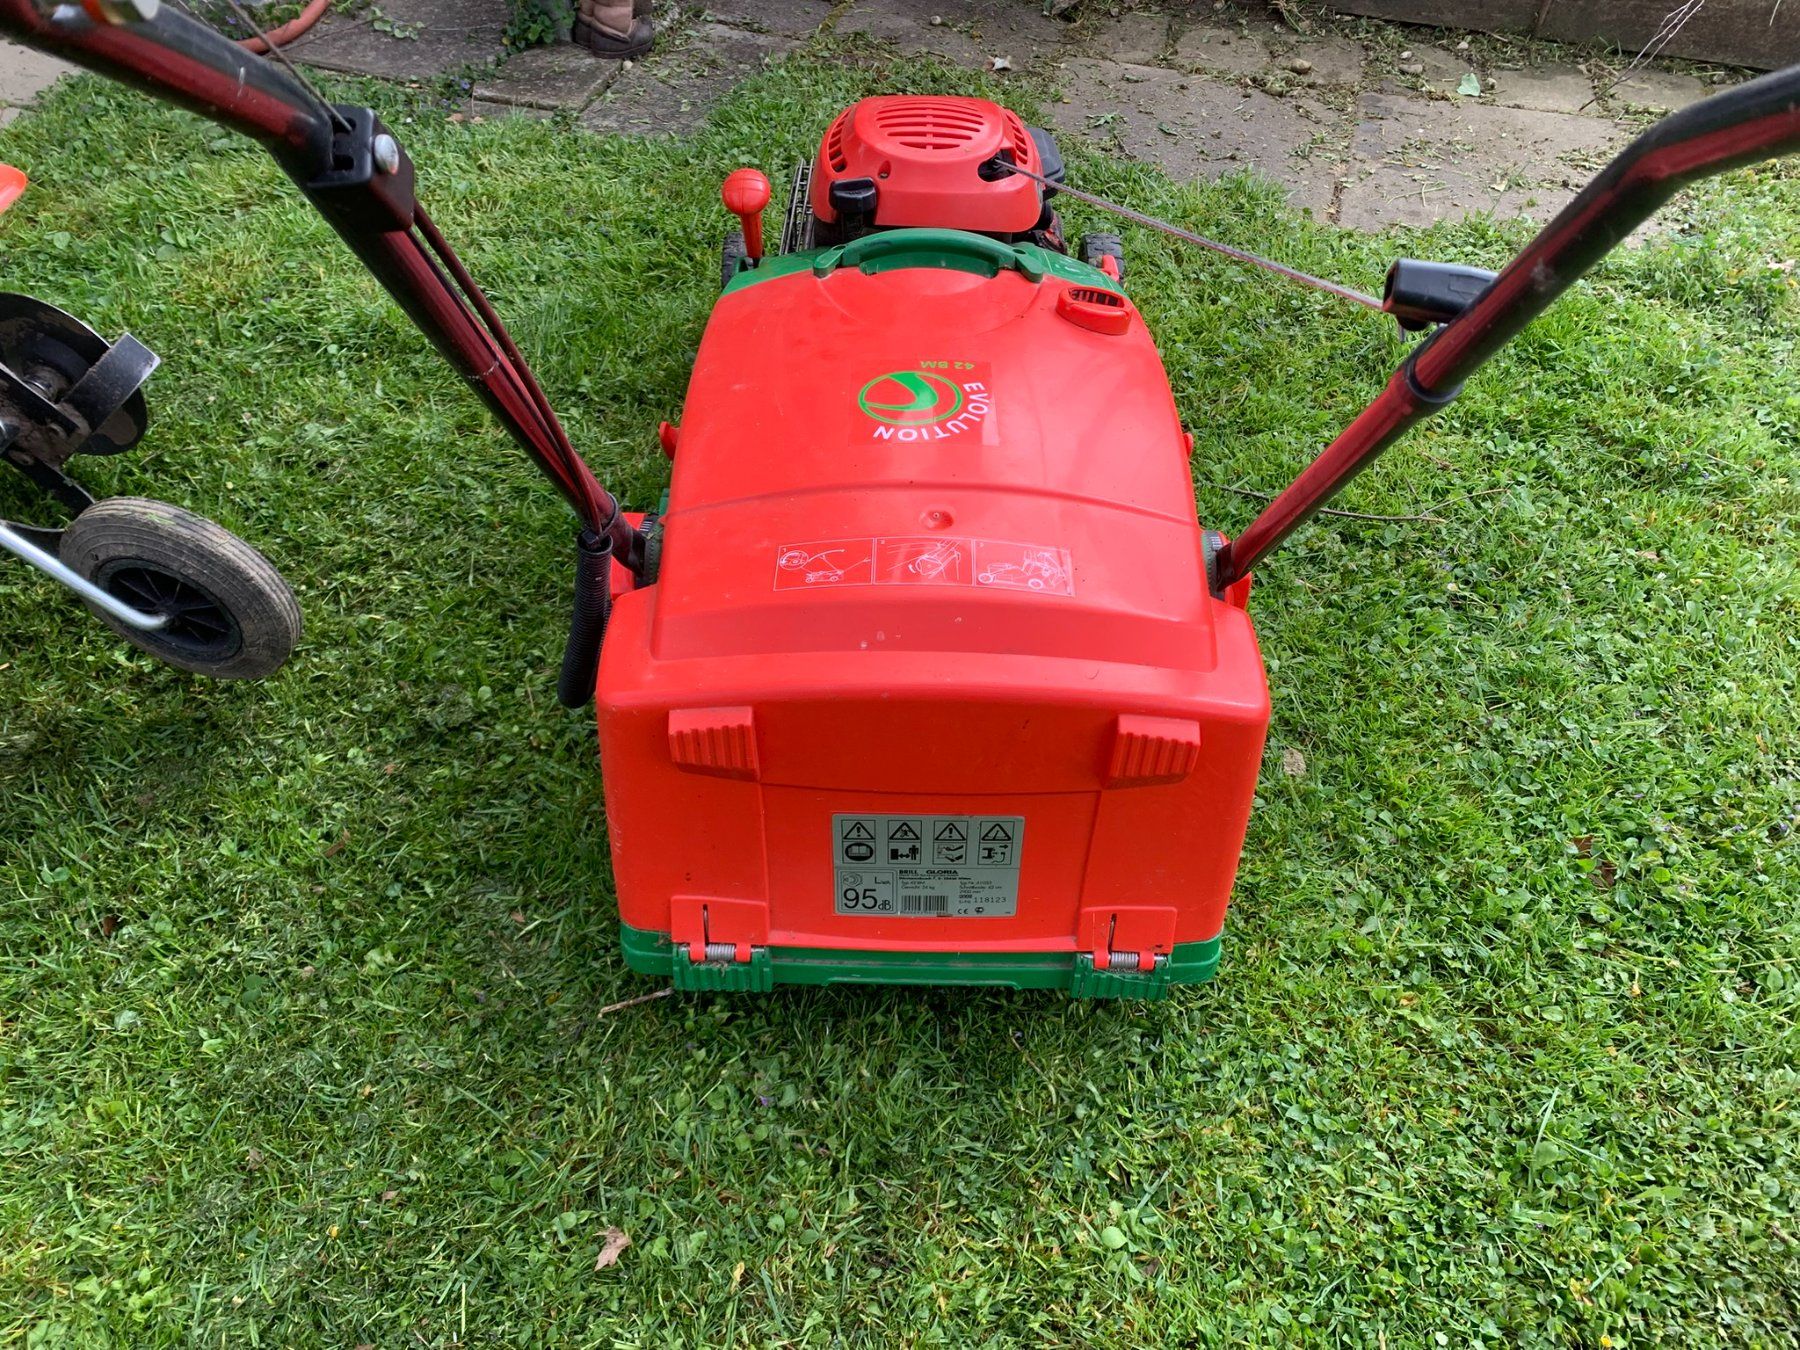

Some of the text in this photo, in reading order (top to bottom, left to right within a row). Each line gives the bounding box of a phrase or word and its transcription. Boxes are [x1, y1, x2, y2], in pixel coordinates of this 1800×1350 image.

[920, 360, 975, 370] 42 BM
[873, 382, 991, 441] EVOLUTION
[843, 888, 892, 911] 95 dB
[974, 896, 1007, 904] 118123
